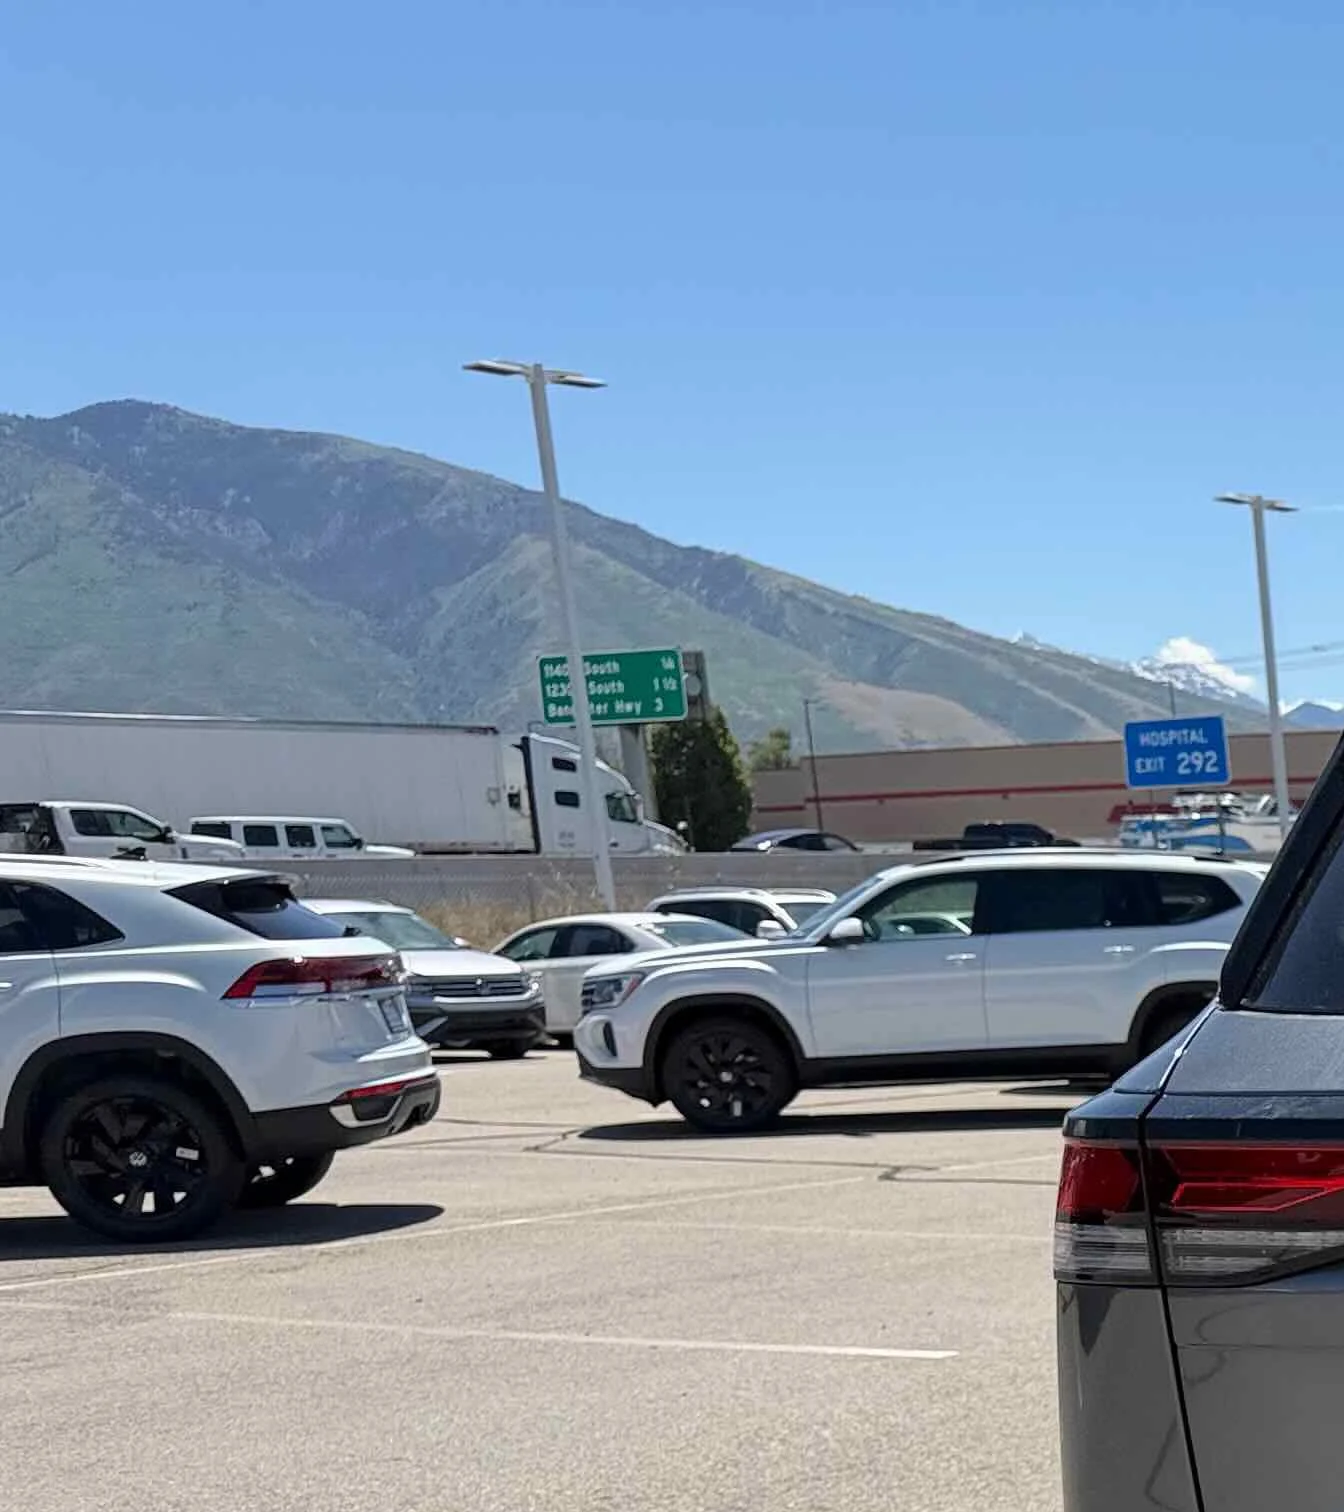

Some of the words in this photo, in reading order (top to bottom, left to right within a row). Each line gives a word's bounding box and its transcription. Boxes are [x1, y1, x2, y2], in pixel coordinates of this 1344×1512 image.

[588, 680, 624, 695] South
[614, 699, 642, 716] Hwy
[653, 698, 664, 713] 3
[1140, 728, 1208, 747] HOSPITAL
[1135, 756, 1166, 774] EXIT
[1177, 749, 1219, 775] 292
